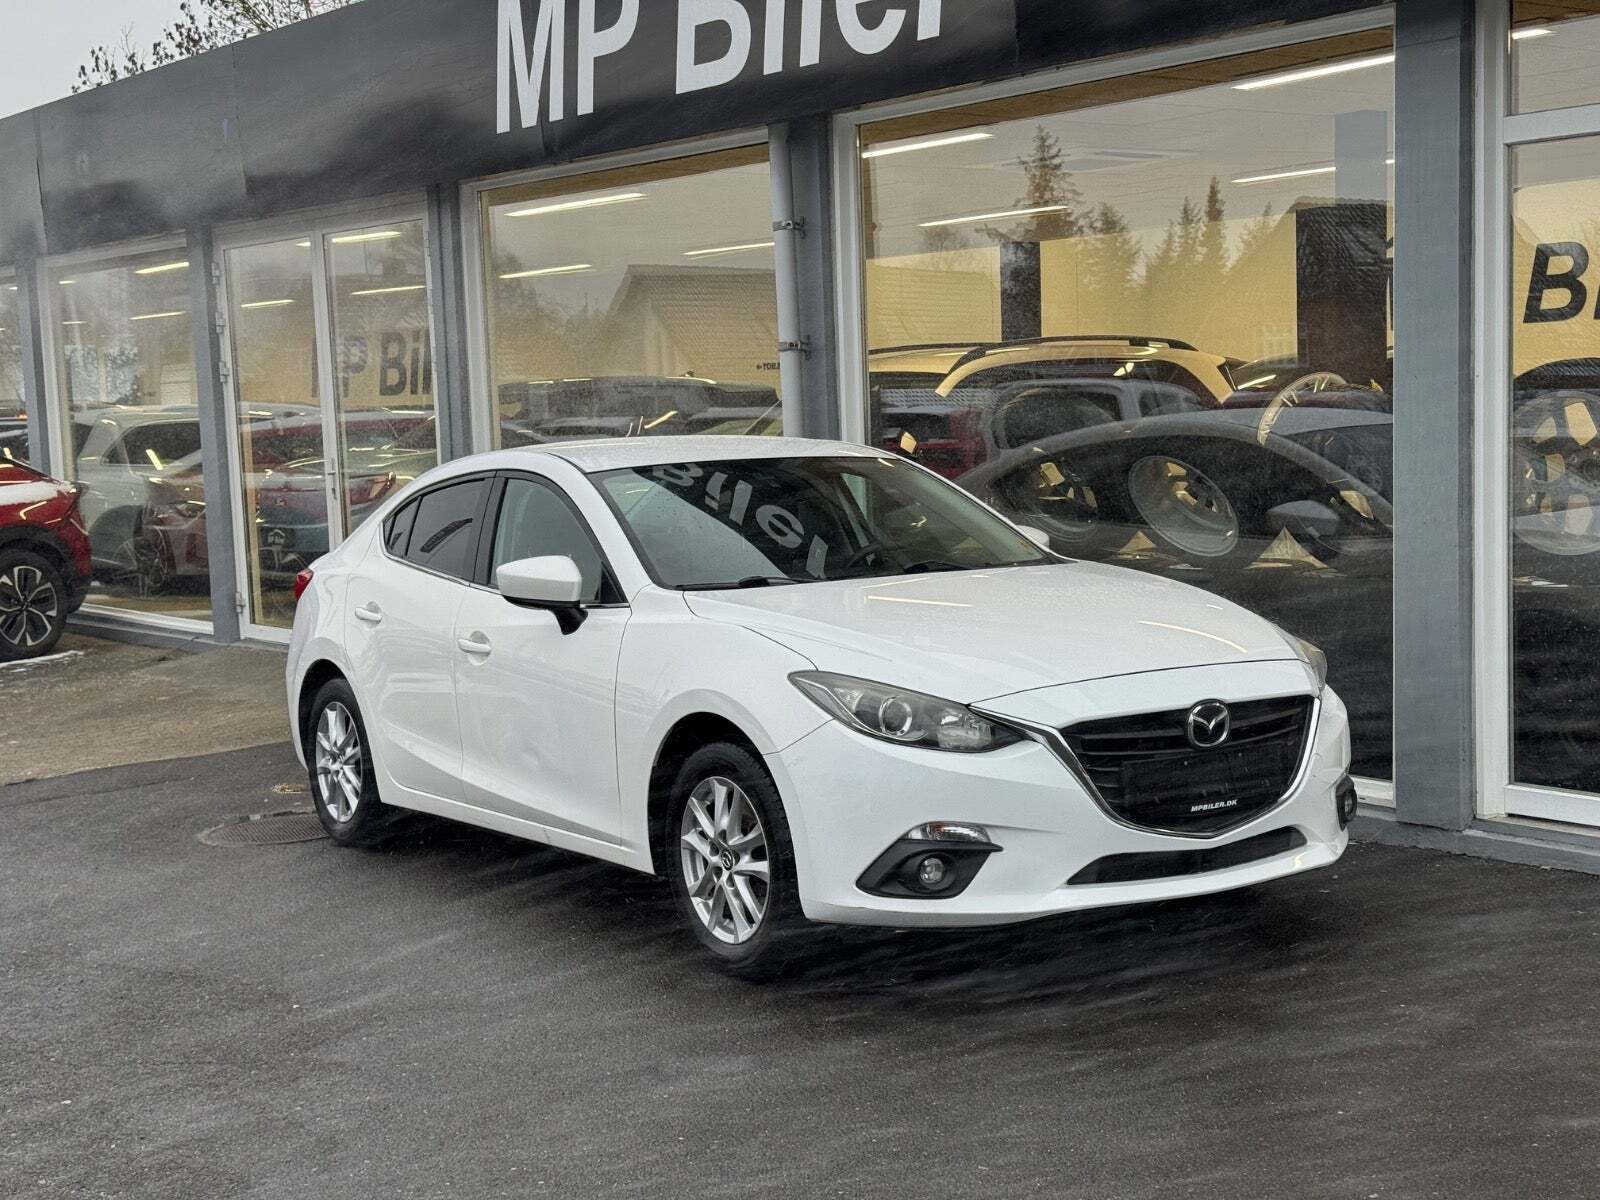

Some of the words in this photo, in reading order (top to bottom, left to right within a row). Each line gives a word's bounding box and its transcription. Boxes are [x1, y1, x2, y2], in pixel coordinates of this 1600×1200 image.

[496, 0, 638, 134] MP
[1523, 241, 1600, 323] B
[1190, 798, 1239, 813] MPBILER.DK
